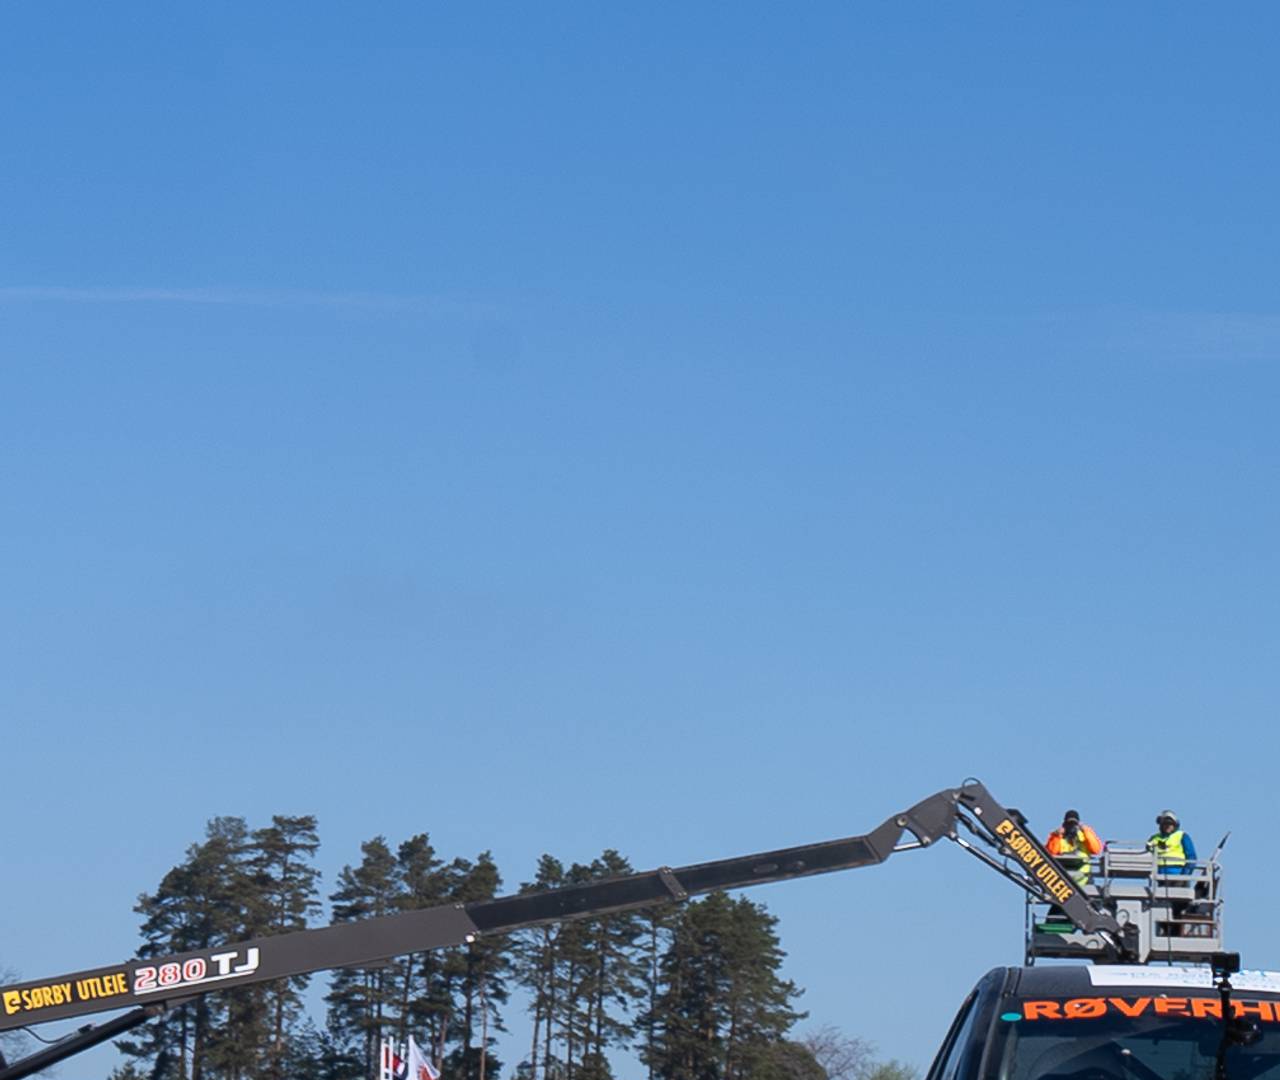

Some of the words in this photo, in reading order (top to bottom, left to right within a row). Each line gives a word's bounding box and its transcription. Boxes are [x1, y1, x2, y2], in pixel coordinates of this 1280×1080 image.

[1005, 830, 1043, 868] SØRBY
[1036, 863, 1073, 903] UTLEIE
[22, 982, 72, 1010] SØRBY
[77, 973, 129, 1000] UTLEIE
[134, 958, 207, 992] 280
[211, 948, 259, 974] TJ
